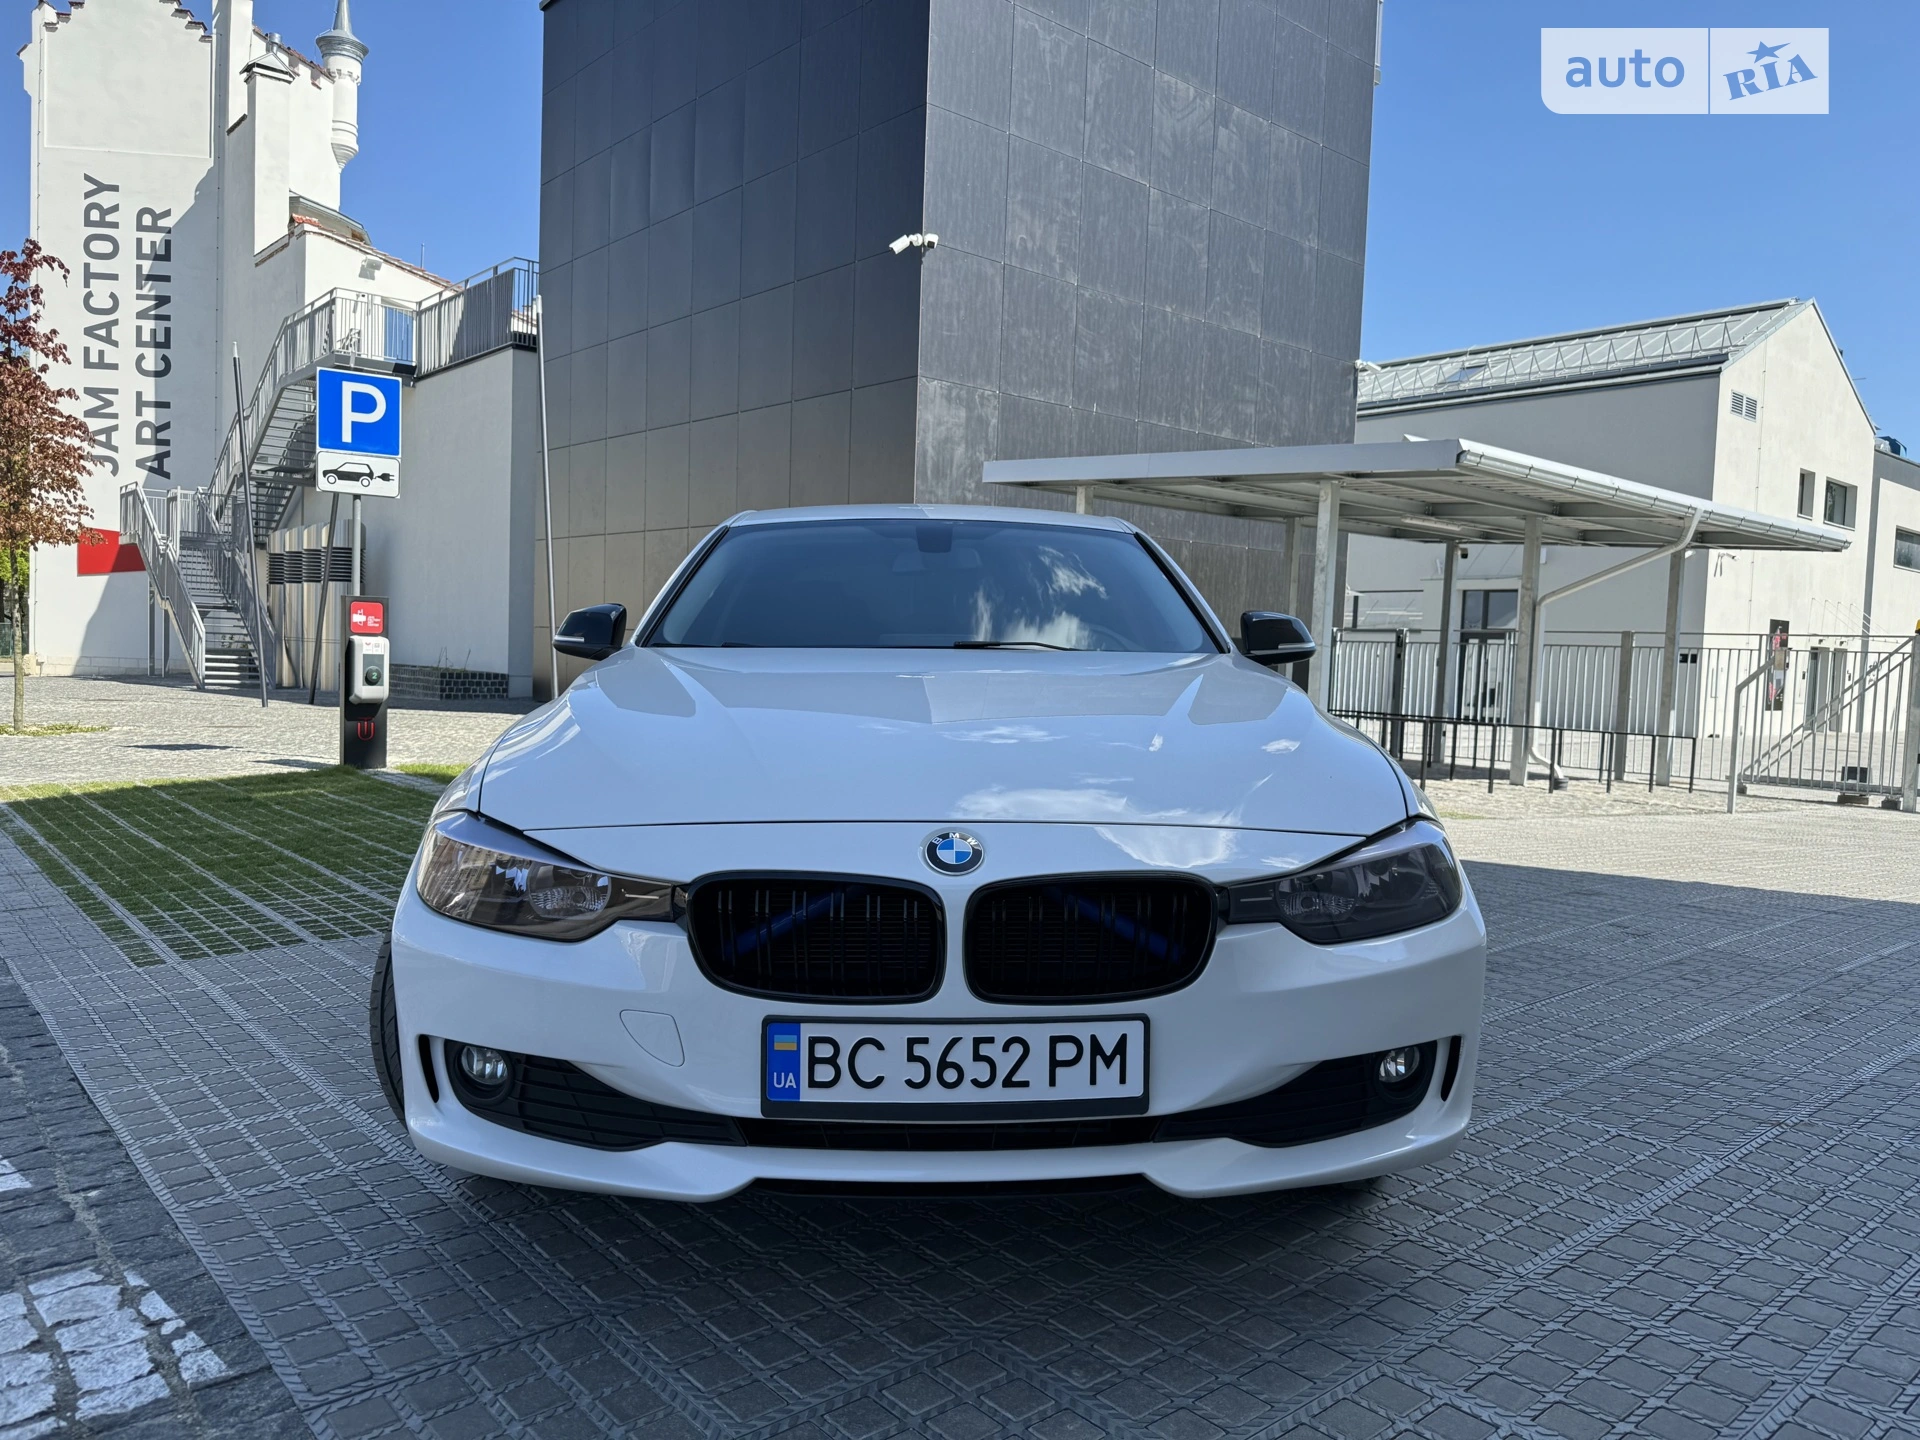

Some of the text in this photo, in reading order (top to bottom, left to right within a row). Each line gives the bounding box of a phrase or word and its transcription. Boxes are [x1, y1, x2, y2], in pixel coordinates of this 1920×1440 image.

[83, 173, 119, 477] JAM FACTORY
[135, 207, 171, 480] ART CENTER
[341, 380, 387, 443] P
[931, 832, 979, 846] BMW
[773, 1072, 797, 1089] UA
[807, 1033, 1128, 1089] BC 5652 PM
